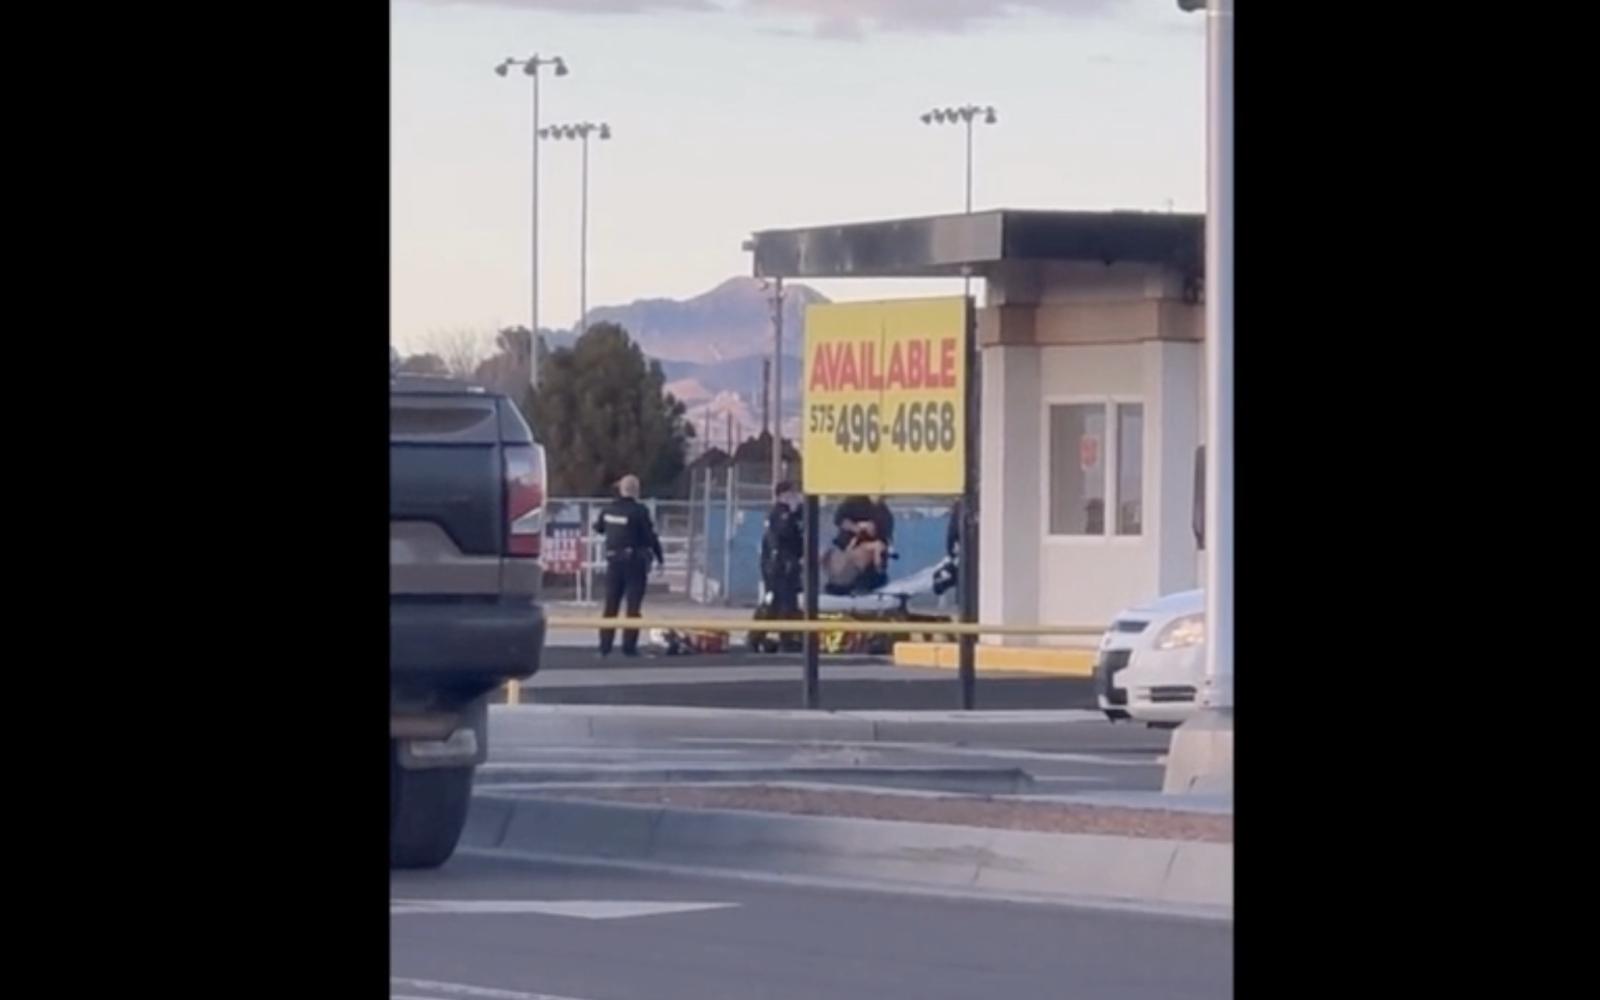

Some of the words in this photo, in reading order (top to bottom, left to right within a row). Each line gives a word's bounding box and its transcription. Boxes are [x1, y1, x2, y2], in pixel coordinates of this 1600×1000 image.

[810, 339, 956, 391] AVAILABLE
[810, 404, 834, 433] 575
[836, 402, 955, 453] 496-4668
